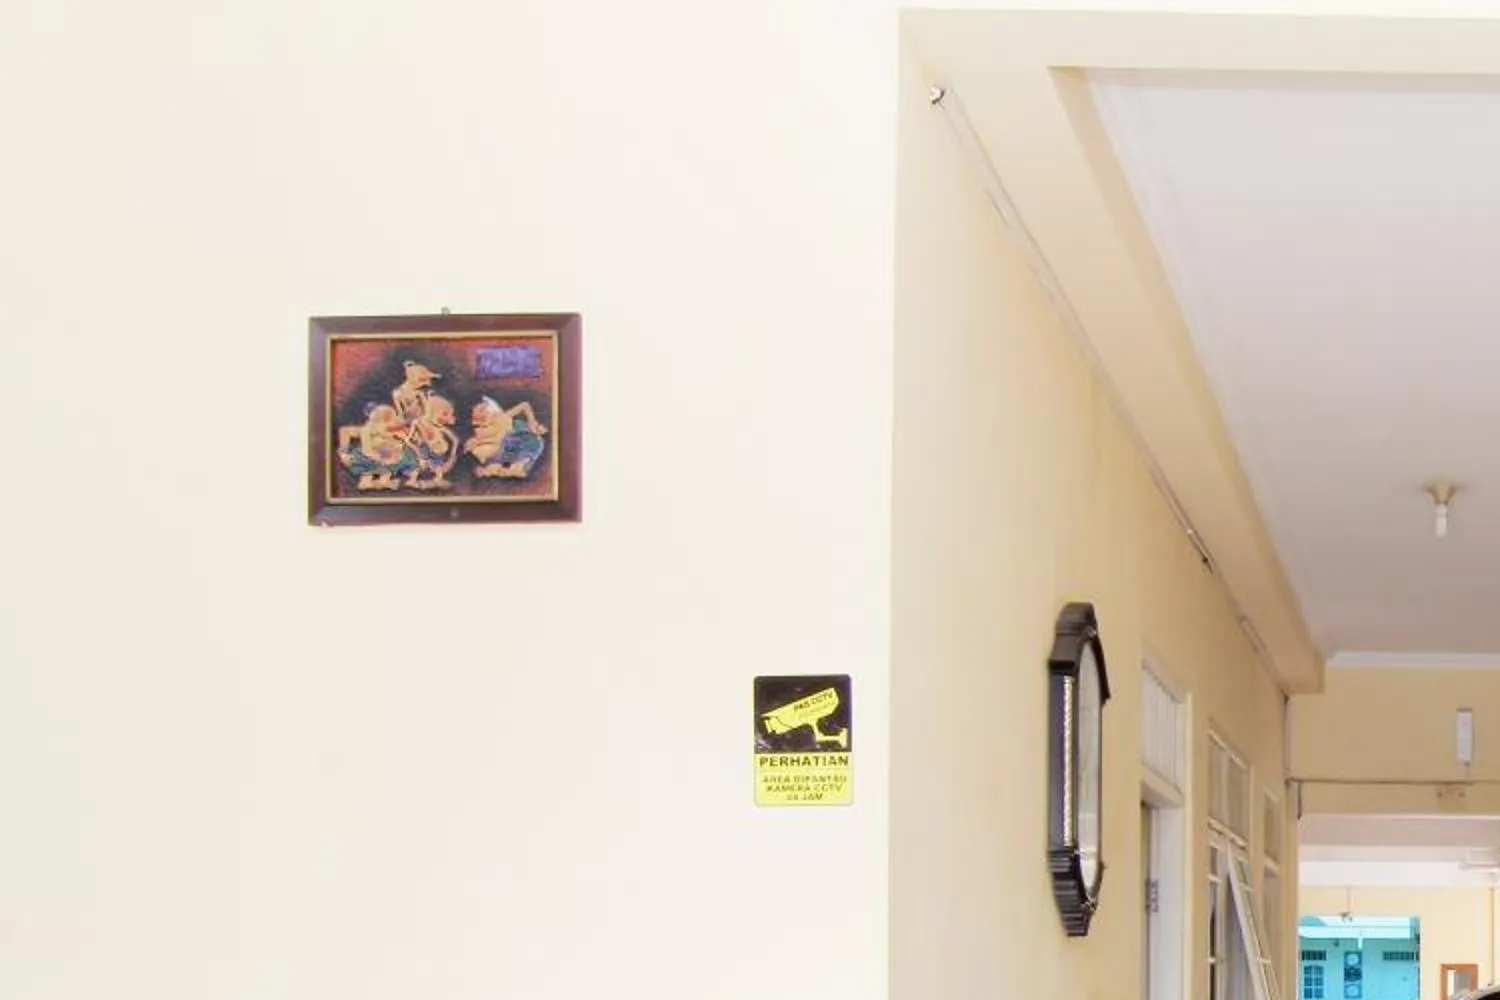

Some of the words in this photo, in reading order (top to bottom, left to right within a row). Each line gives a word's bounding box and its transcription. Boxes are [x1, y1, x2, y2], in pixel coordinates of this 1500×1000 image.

[759, 755, 849, 767] PERHATIAN
[762, 775, 790, 783] AREA
[793, 774, 847, 783] DIPANTAU
[766, 784, 811, 792] KAMERA
[814, 783, 843, 792] CCTV
[801, 793, 823, 801] JAM
